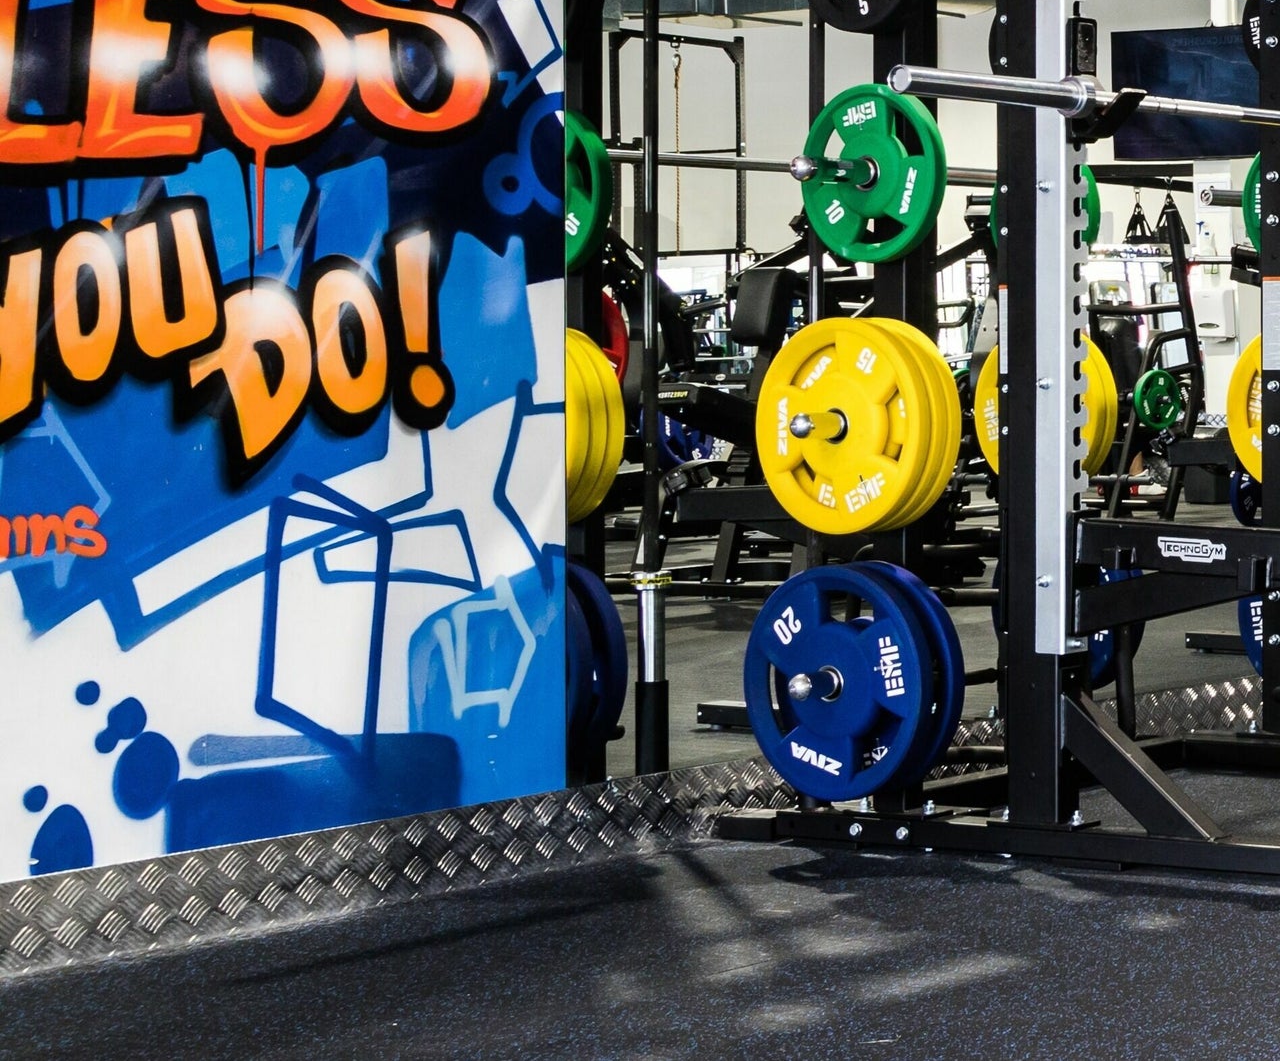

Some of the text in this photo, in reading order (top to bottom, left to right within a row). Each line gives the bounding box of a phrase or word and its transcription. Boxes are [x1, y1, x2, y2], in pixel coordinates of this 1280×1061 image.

[842, 99, 878, 128] EMF
[824, 198, 846, 225] 10
[898, 166, 918, 215] ZIVA
[190, 228, 452, 462] DO!
[855, 346, 879, 376] 15
[776, 396, 789, 456] ZIVA
[843, 471, 887, 515] EMF
[772, 605, 802, 646] 20
[877, 635, 906, 698] EMF
[790, 740, 843, 777] ZIVA
